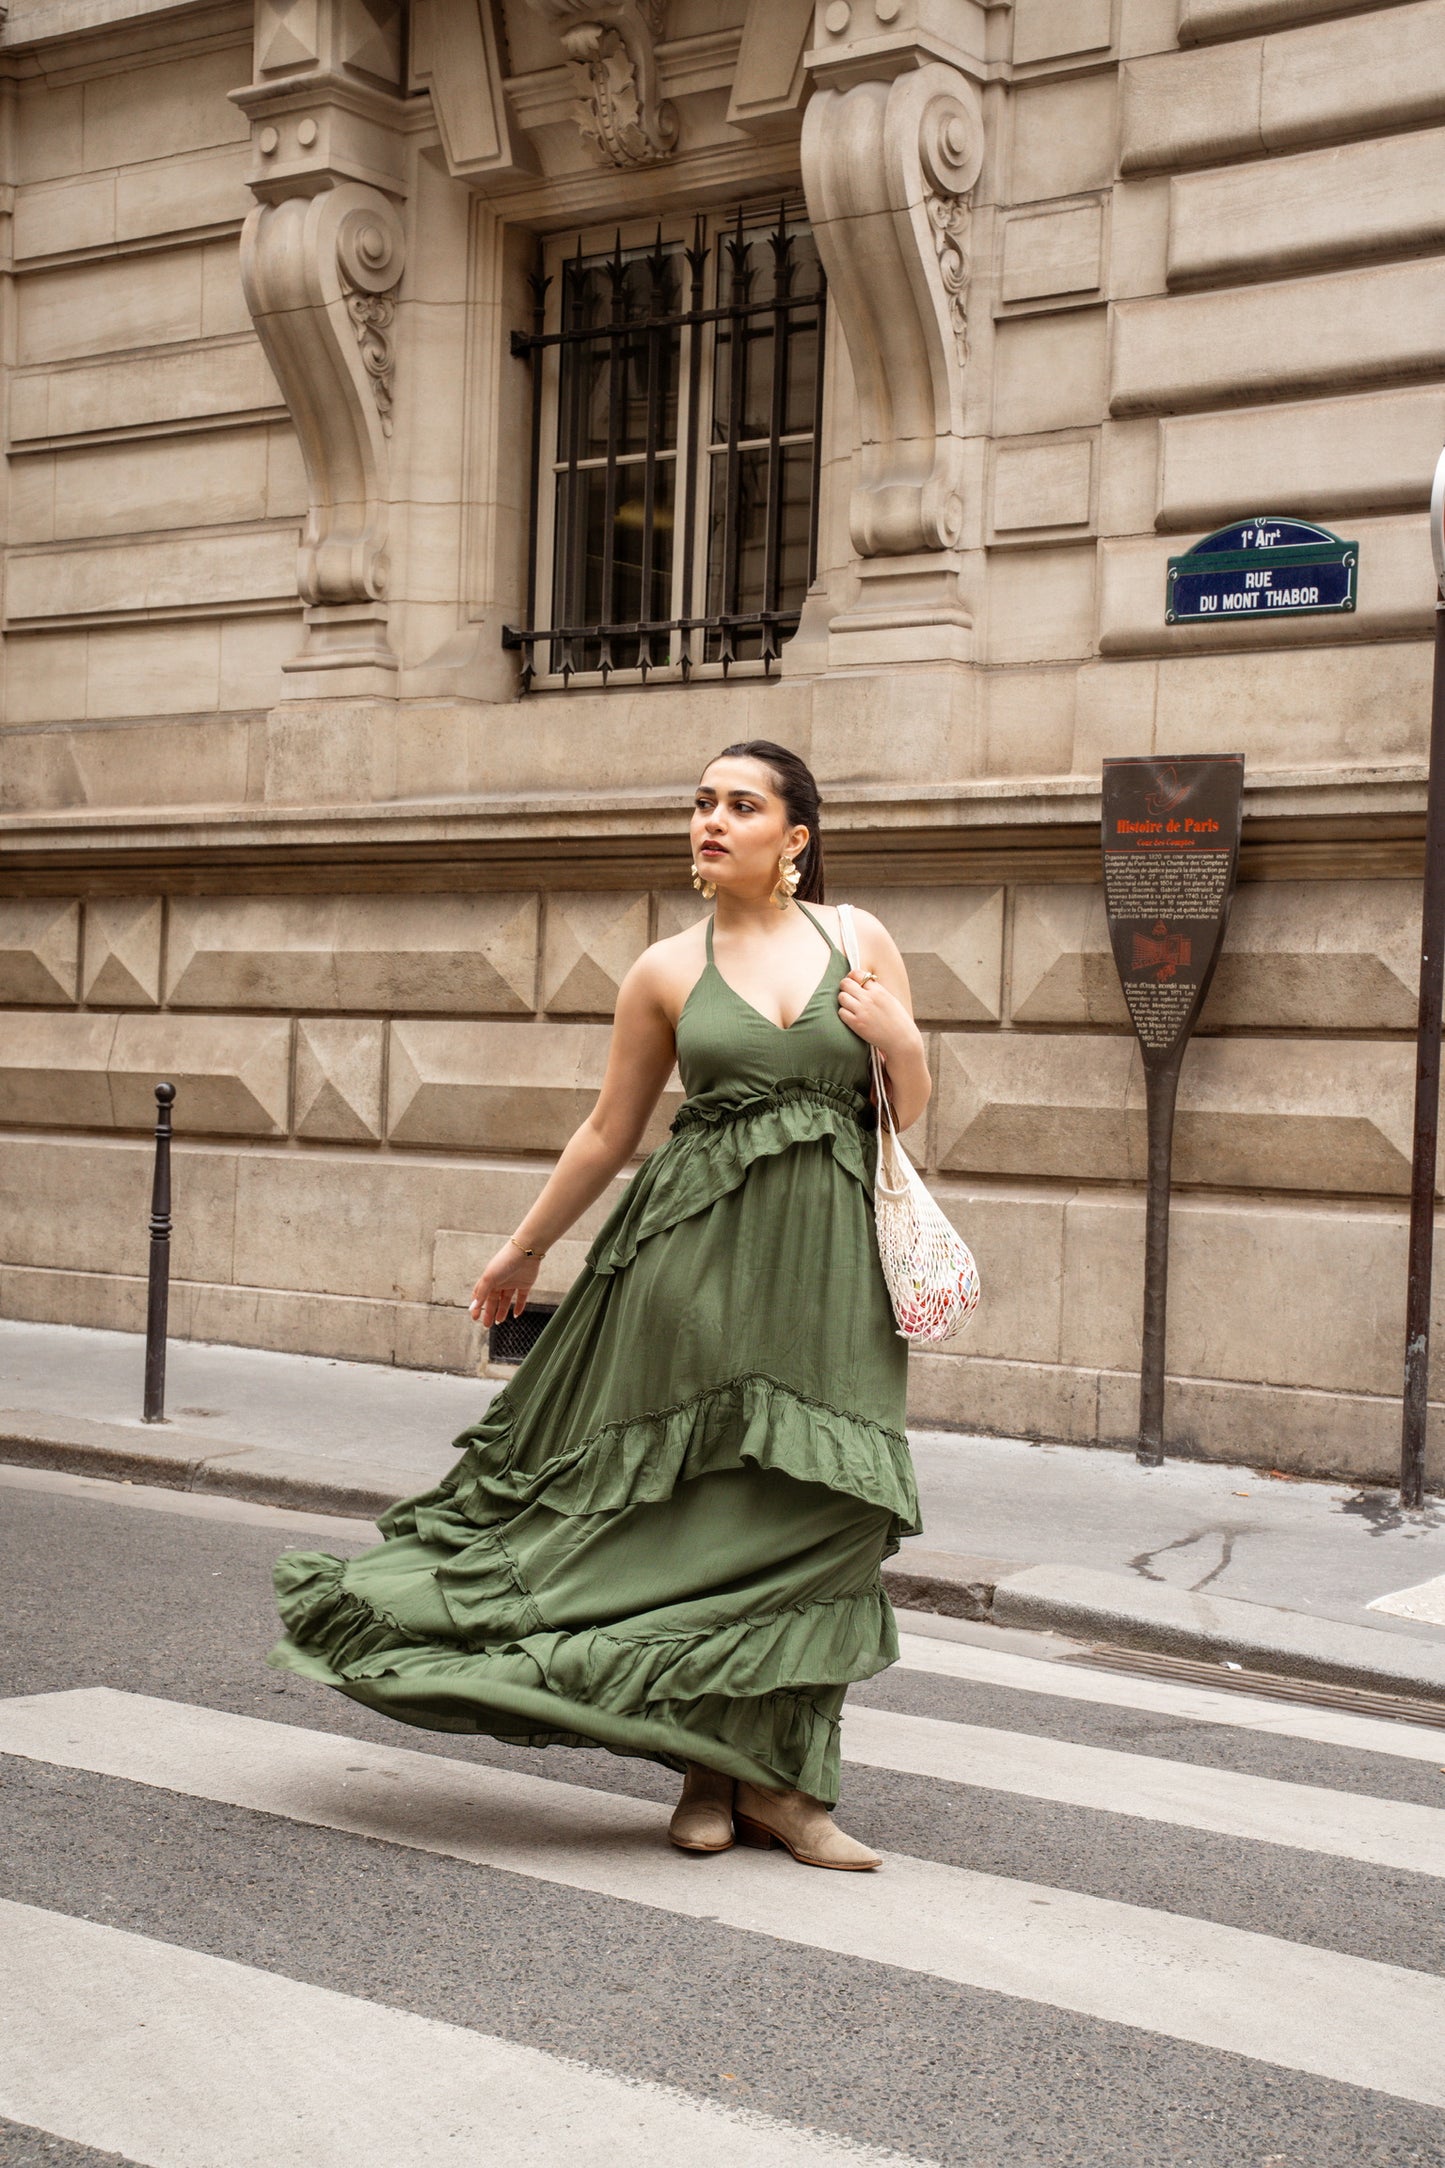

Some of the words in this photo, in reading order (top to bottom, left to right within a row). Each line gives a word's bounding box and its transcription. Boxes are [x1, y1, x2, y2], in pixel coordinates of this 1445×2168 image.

[1245, 571, 1272, 588] RUE
[1200, 595, 1217, 612] DU
[1222, 592, 1260, 610] MONT
[1265, 587, 1319, 606] THABOR
[1117, 818, 1163, 833] Histoire
[1166, 818, 1181, 833] de
[1184, 818, 1219, 833] Paris
